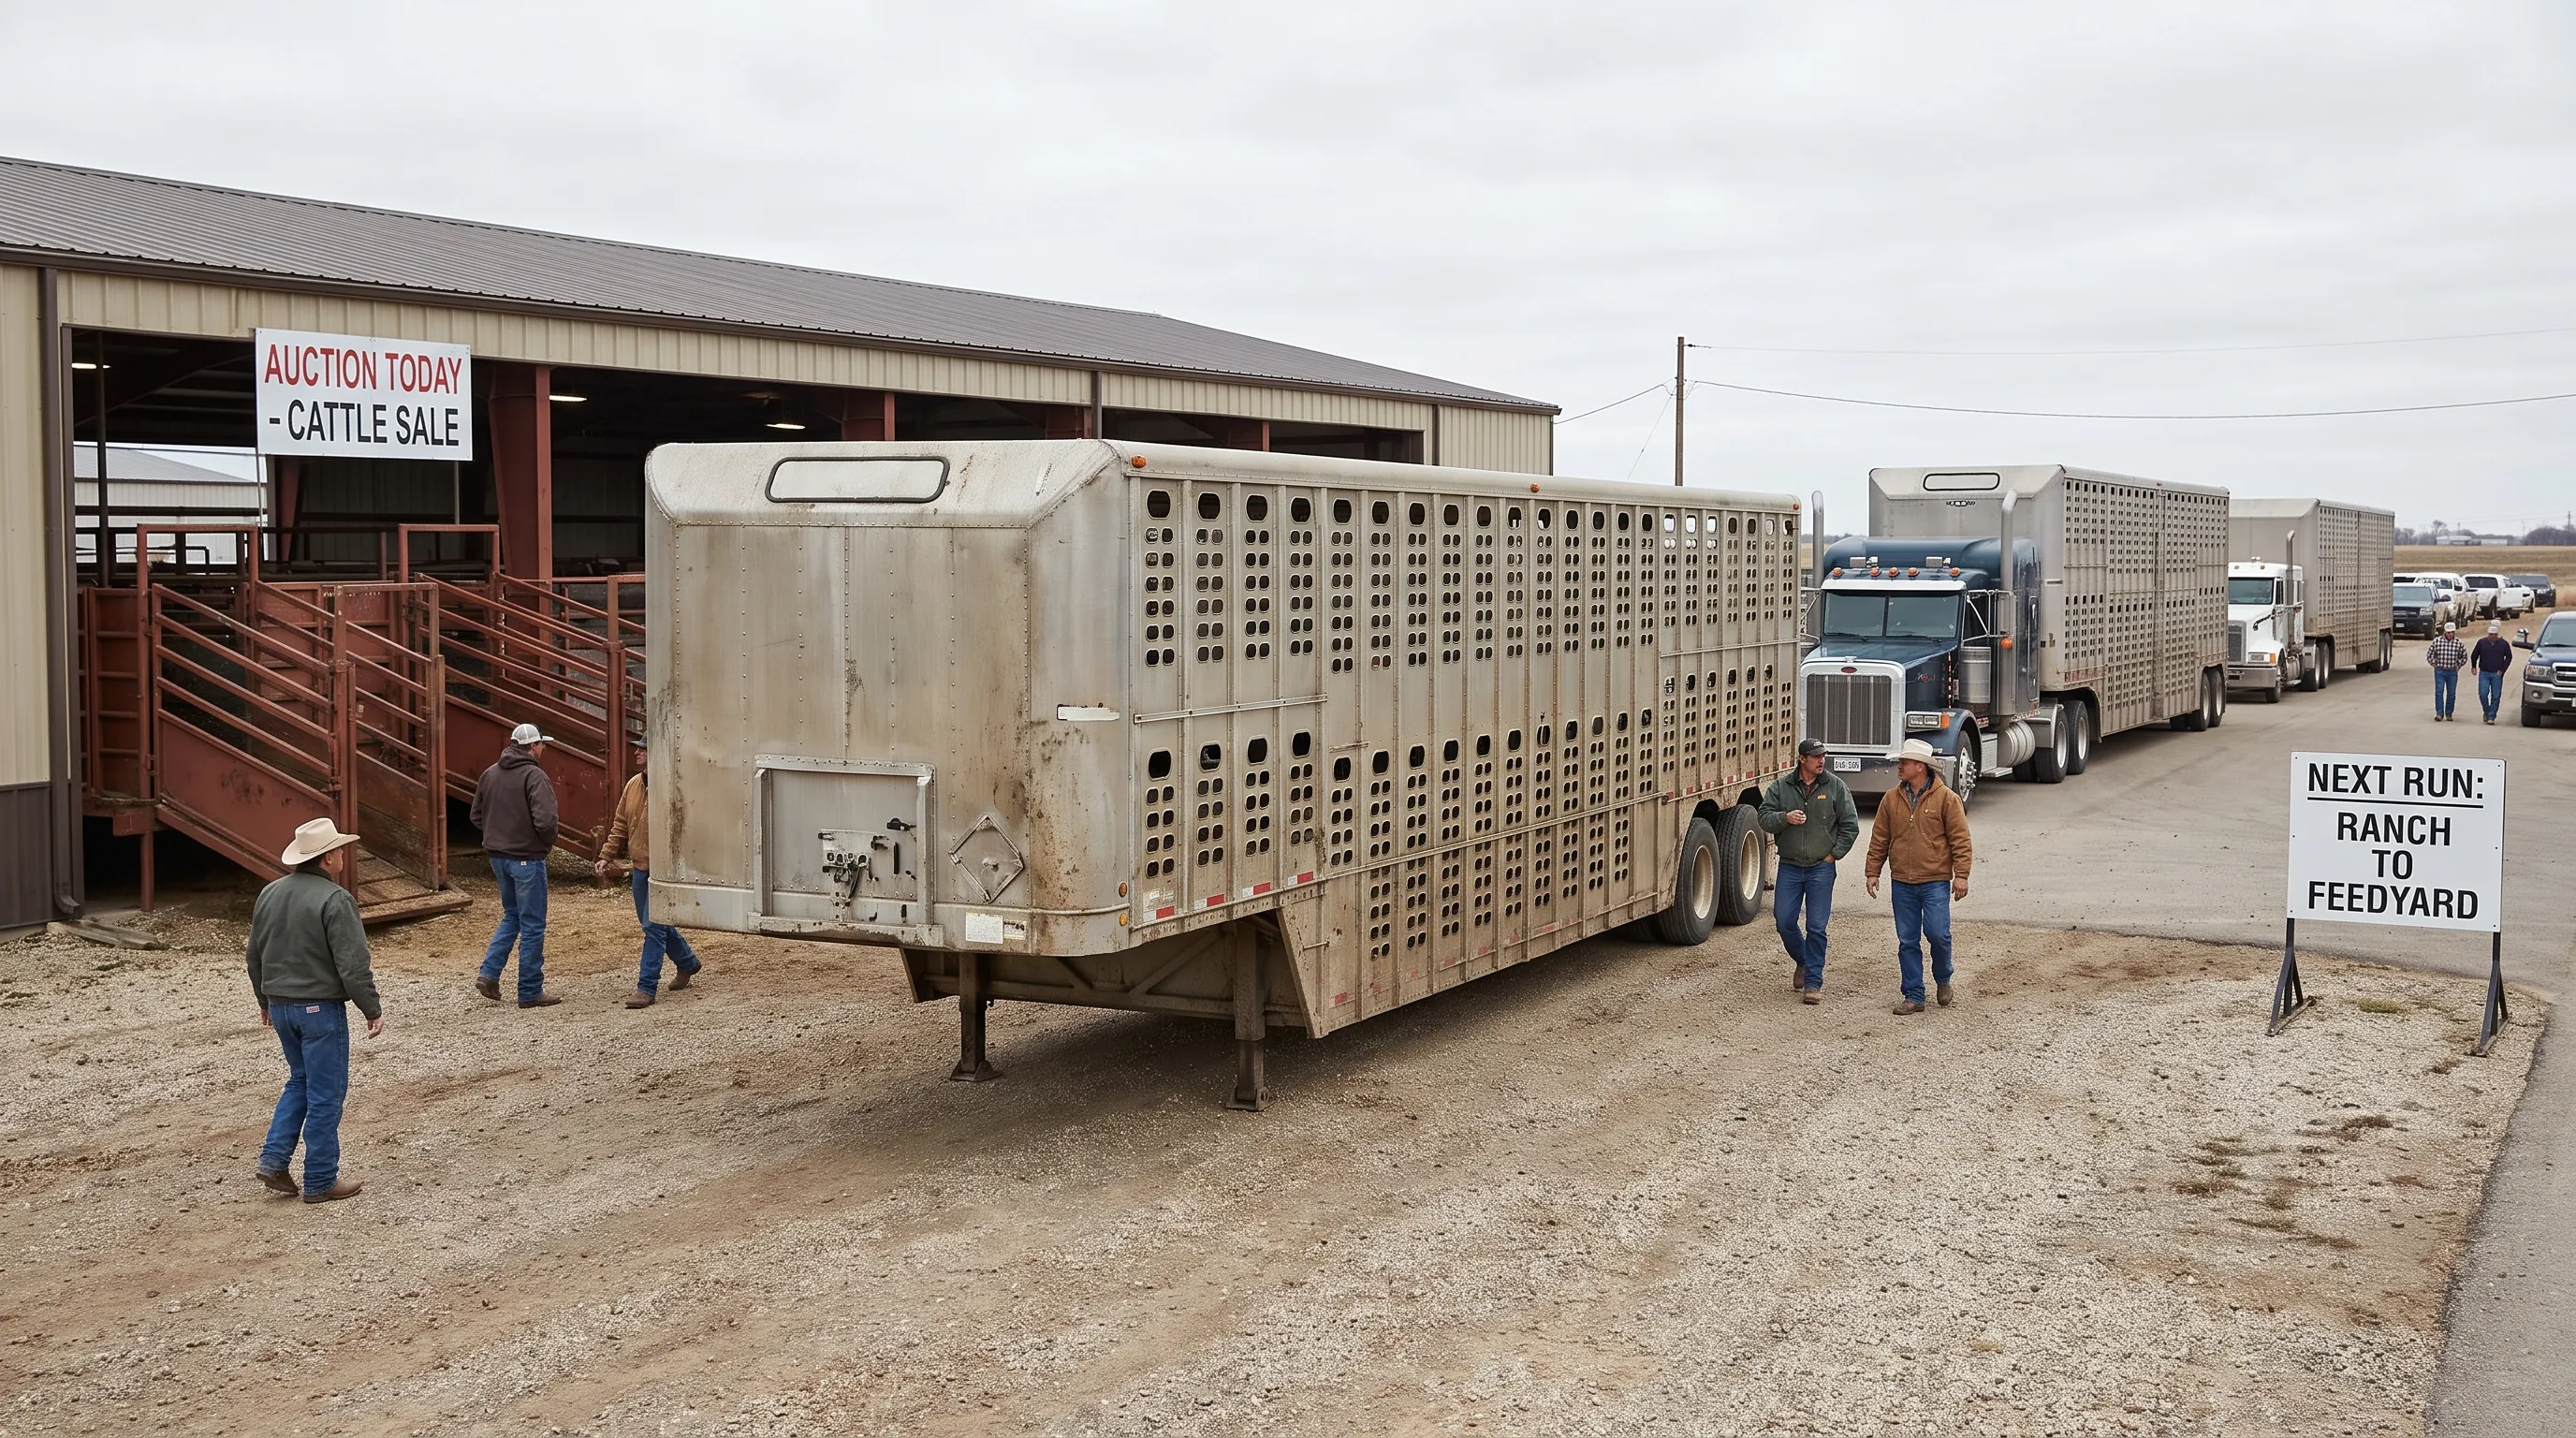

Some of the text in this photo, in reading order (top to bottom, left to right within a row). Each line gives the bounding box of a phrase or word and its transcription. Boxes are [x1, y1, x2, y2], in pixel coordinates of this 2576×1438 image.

[264, 344, 461, 394] AUCTION TODAY
[287, 399, 387, 443] CATTLE
[395, 404, 459, 446] SALE
[2308, 762, 2482, 799] NEXT RUN:
[2337, 812, 2451, 845] RANCH
[2371, 849, 2412, 879] TO
[2308, 880, 2478, 918] FEEDYARD
